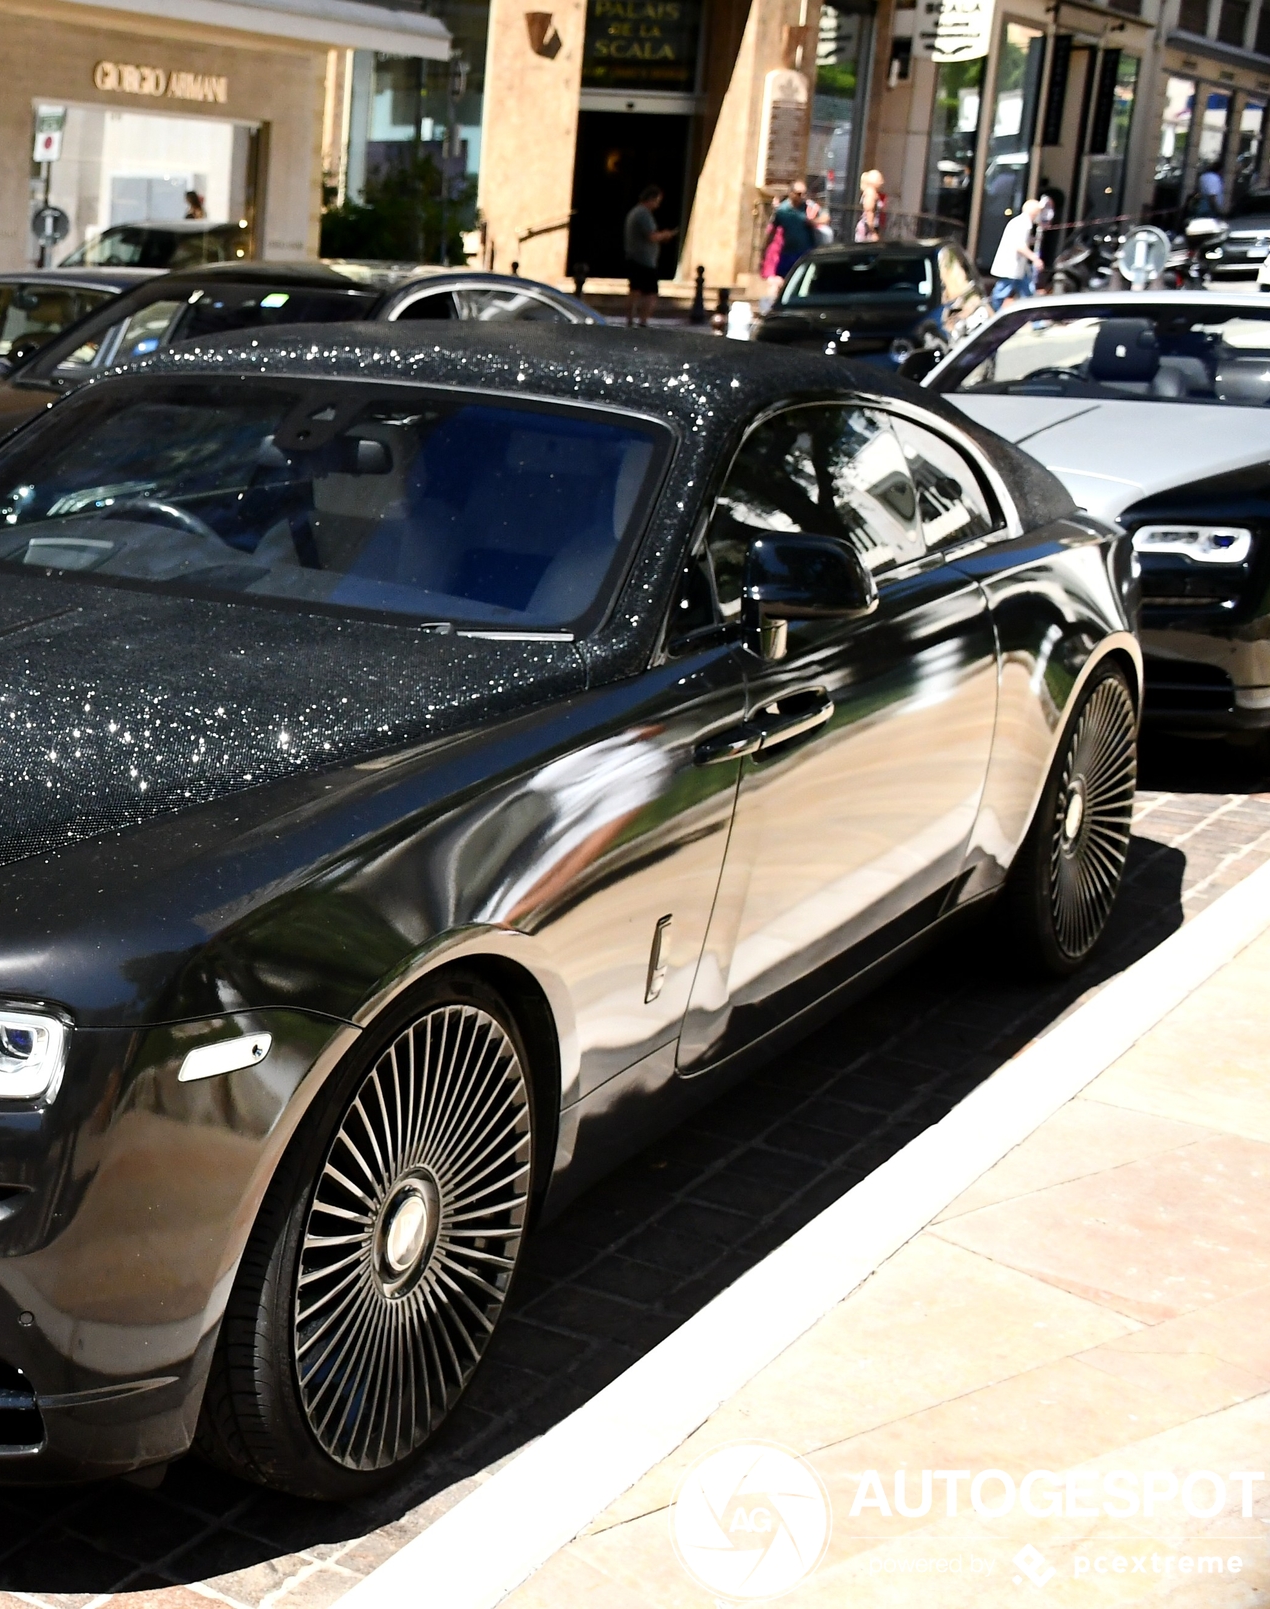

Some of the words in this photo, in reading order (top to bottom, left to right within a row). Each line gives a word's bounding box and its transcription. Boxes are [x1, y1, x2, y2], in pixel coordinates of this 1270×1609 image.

[594, 0, 680, 19] PALAIS
[639, 23, 662, 38] LA
[593, 39, 675, 60] SCALA
[94, 60, 167, 97] GIORGIO
[167, 70, 228, 104] ARMANI
